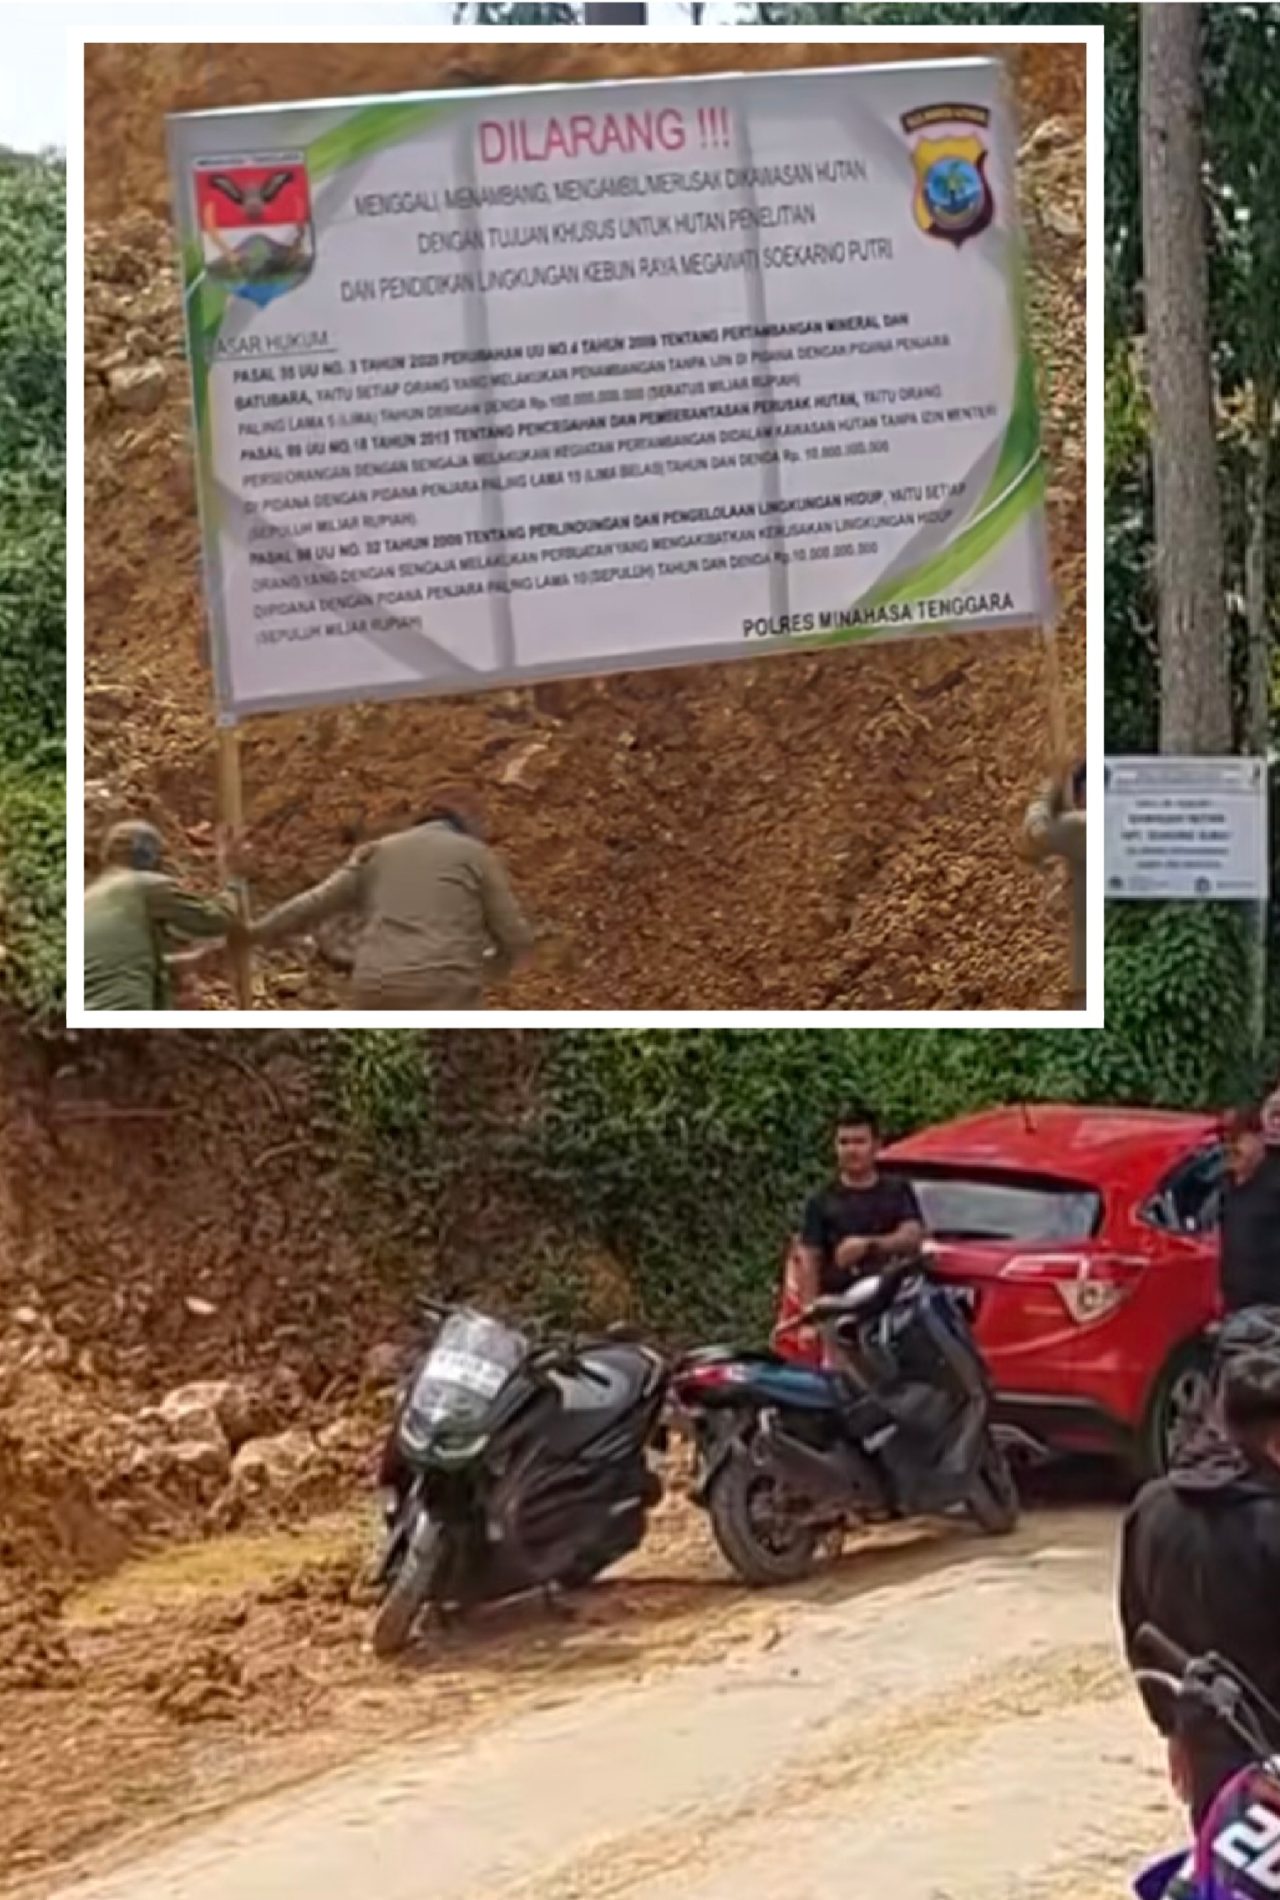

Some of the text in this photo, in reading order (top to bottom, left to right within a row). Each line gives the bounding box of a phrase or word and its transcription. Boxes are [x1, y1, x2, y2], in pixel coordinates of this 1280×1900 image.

[478, 104, 730, 165] DILARANG !!!
[816, 157, 867, 181] HUTAN
[417, 202, 815, 254] DENGAN TUJUAN KHUSUS UNTUK HUTAN PENELITIAN
[340, 236, 893, 303] DAN PENDIDIKAN LINGKUNGAN KEBUN RAYA MEGAWATI SOEKARNO PUTRI
[217, 333, 261, 354] ASAR
[743, 590, 1014, 638] POLRES MINAHASA TENGGARA
